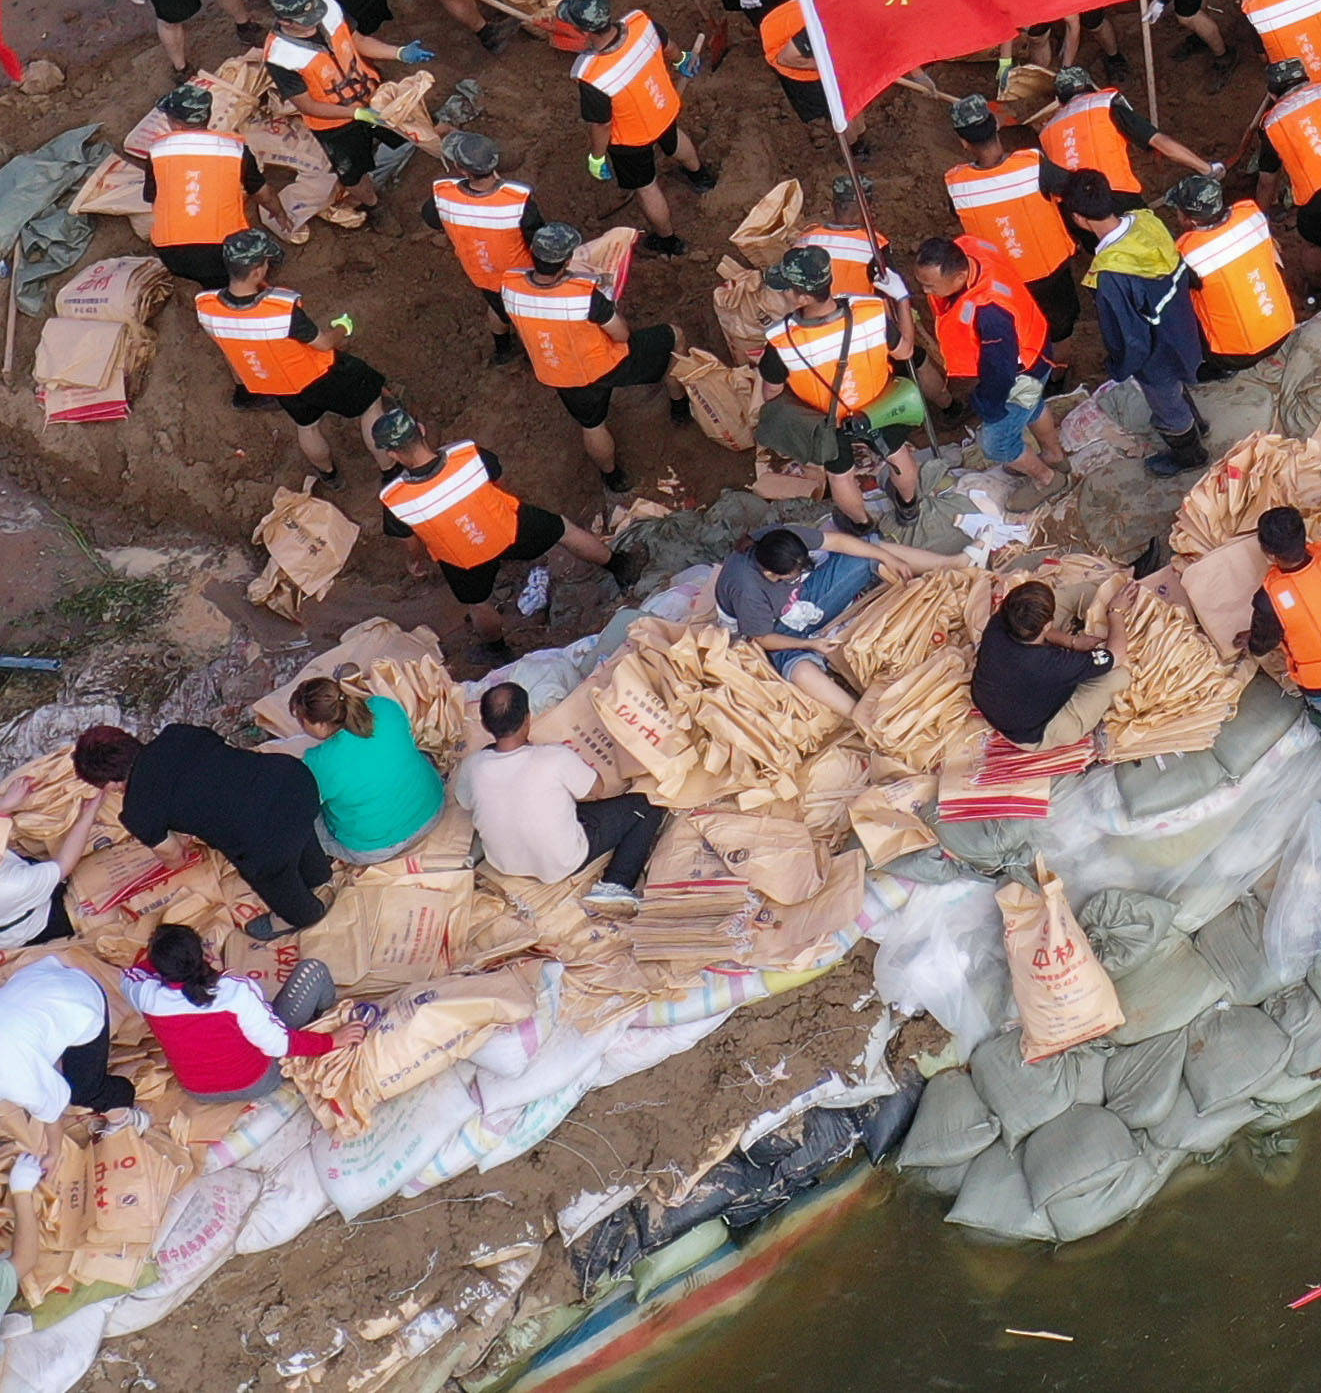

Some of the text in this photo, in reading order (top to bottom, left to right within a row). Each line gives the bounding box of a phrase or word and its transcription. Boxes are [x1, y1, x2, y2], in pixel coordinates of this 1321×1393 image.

[184, 170, 201, 217] 河南武警
[996, 215, 1024, 259] 河南武警
[1247, 266, 1275, 318] 河南武警
[1032, 938, 1076, 970] 中材
